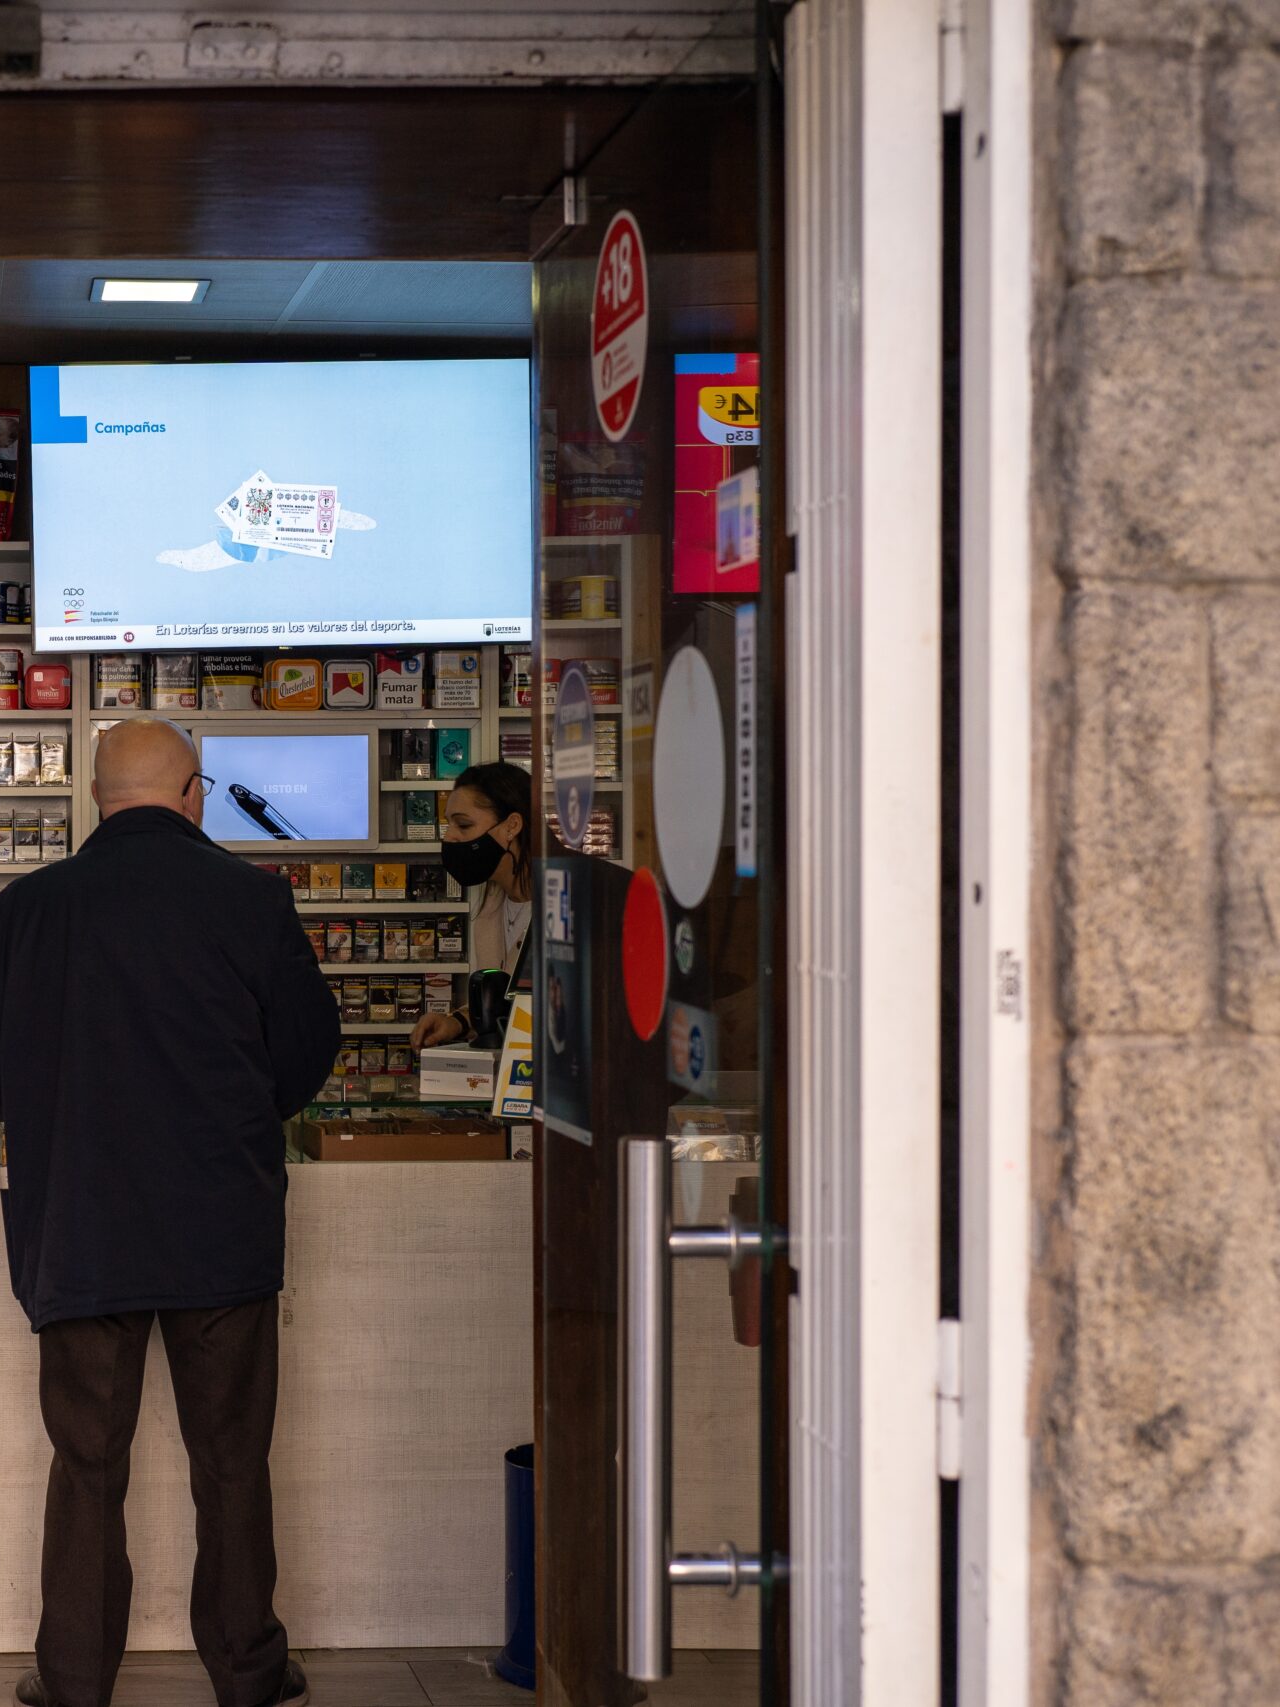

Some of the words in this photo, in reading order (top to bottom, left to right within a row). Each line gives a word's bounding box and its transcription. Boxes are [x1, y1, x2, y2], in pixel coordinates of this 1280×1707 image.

[602, 231, 633, 310] +18
[95, 420, 166, 437] Campañas
[156, 625, 171, 636] En
[173, 623, 219, 636] Loterías
[221, 625, 268, 635] creemos
[271, 625, 285, 633] en
[288, 622, 304, 633] los
[307, 621, 347, 633] valores
[350, 621, 367, 632] del
[370, 620, 415, 634] deporte.
[223, 655, 252, 663] provoca
[279, 674, 315, 697] Chesterfield
[381, 682, 418, 693] Fumar
[384, 695, 414, 705] mata
[263, 785, 292, 793] LISTO
[294, 784, 307, 793] EN
